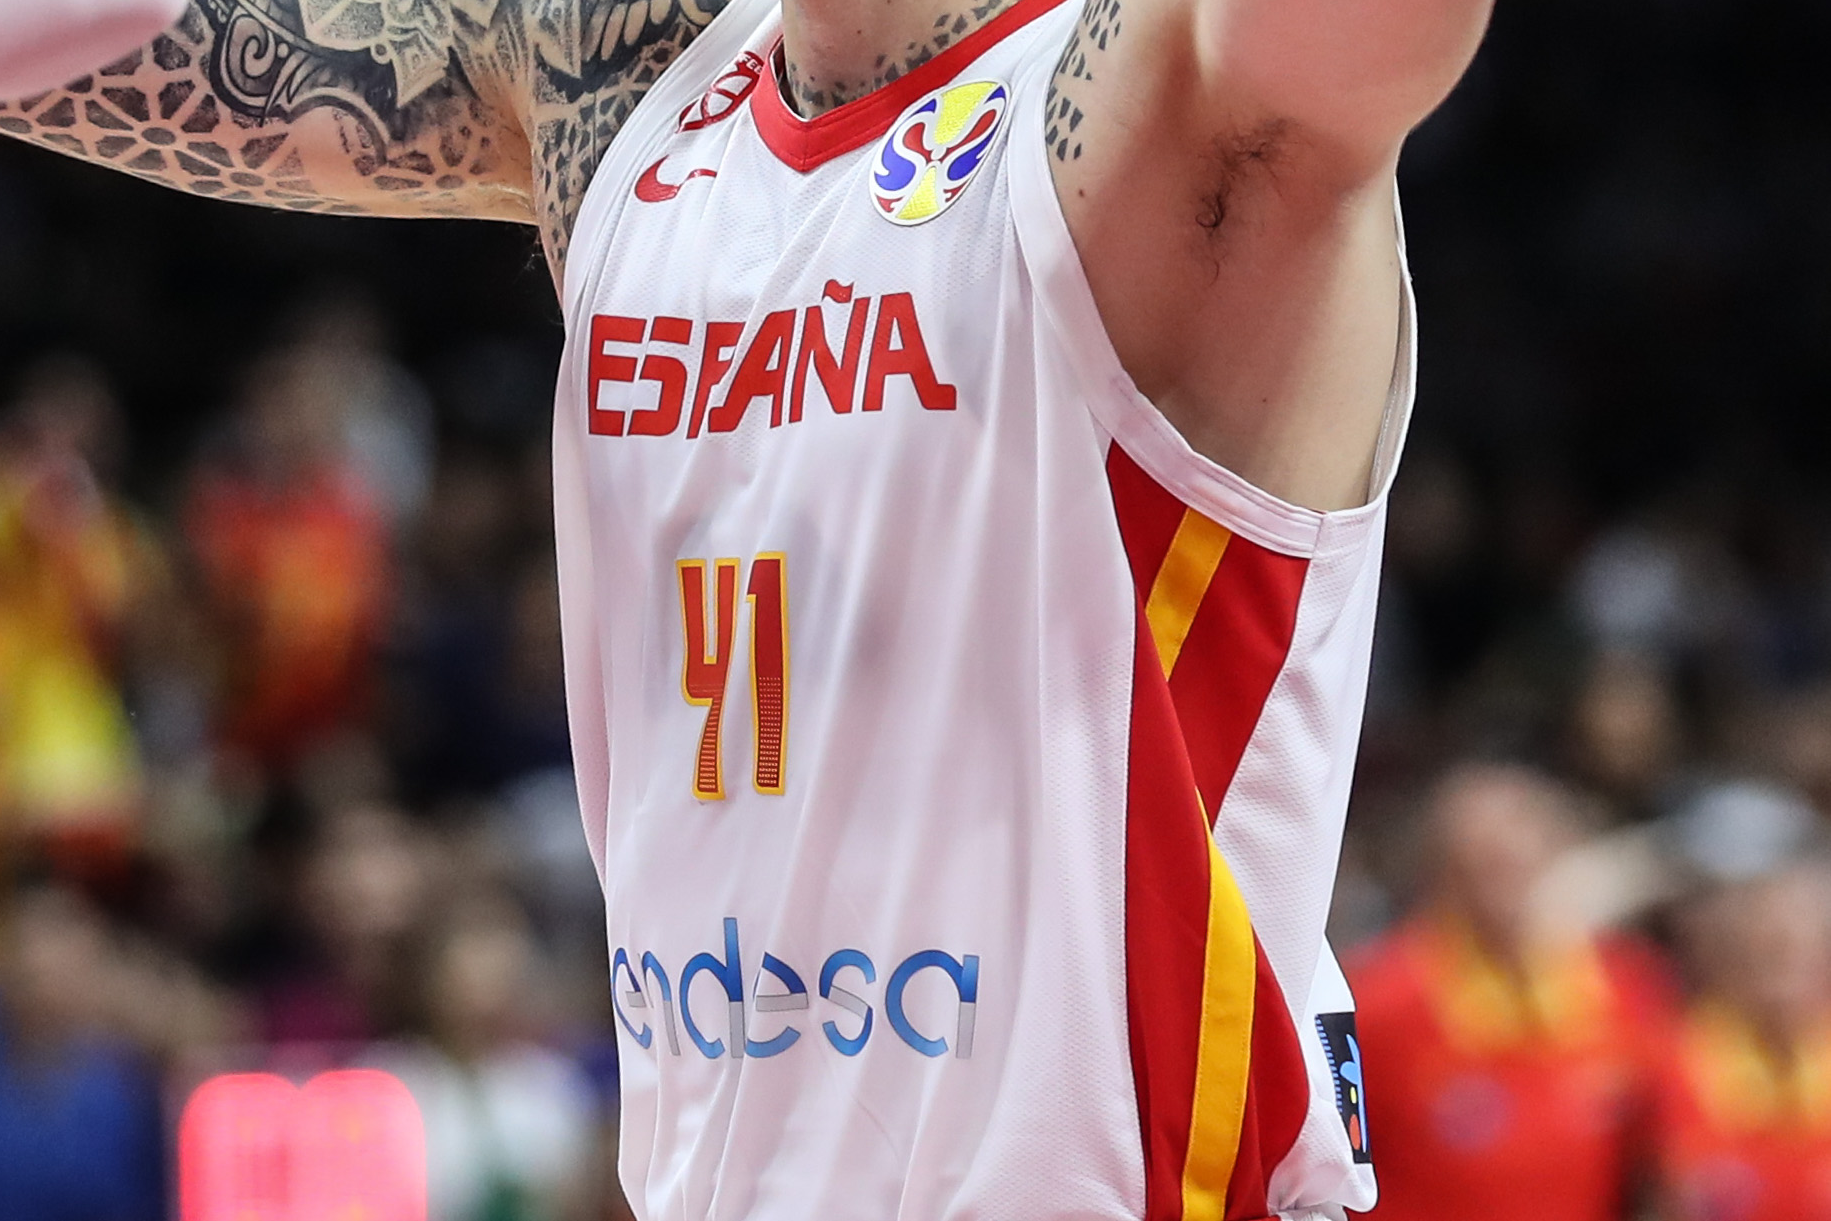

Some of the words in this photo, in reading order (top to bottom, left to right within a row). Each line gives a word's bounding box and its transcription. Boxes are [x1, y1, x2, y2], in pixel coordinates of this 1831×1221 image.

[588, 279, 957, 440] ESPAÑA
[675, 551, 790, 800] 41
[611, 917, 980, 1059] endesa
